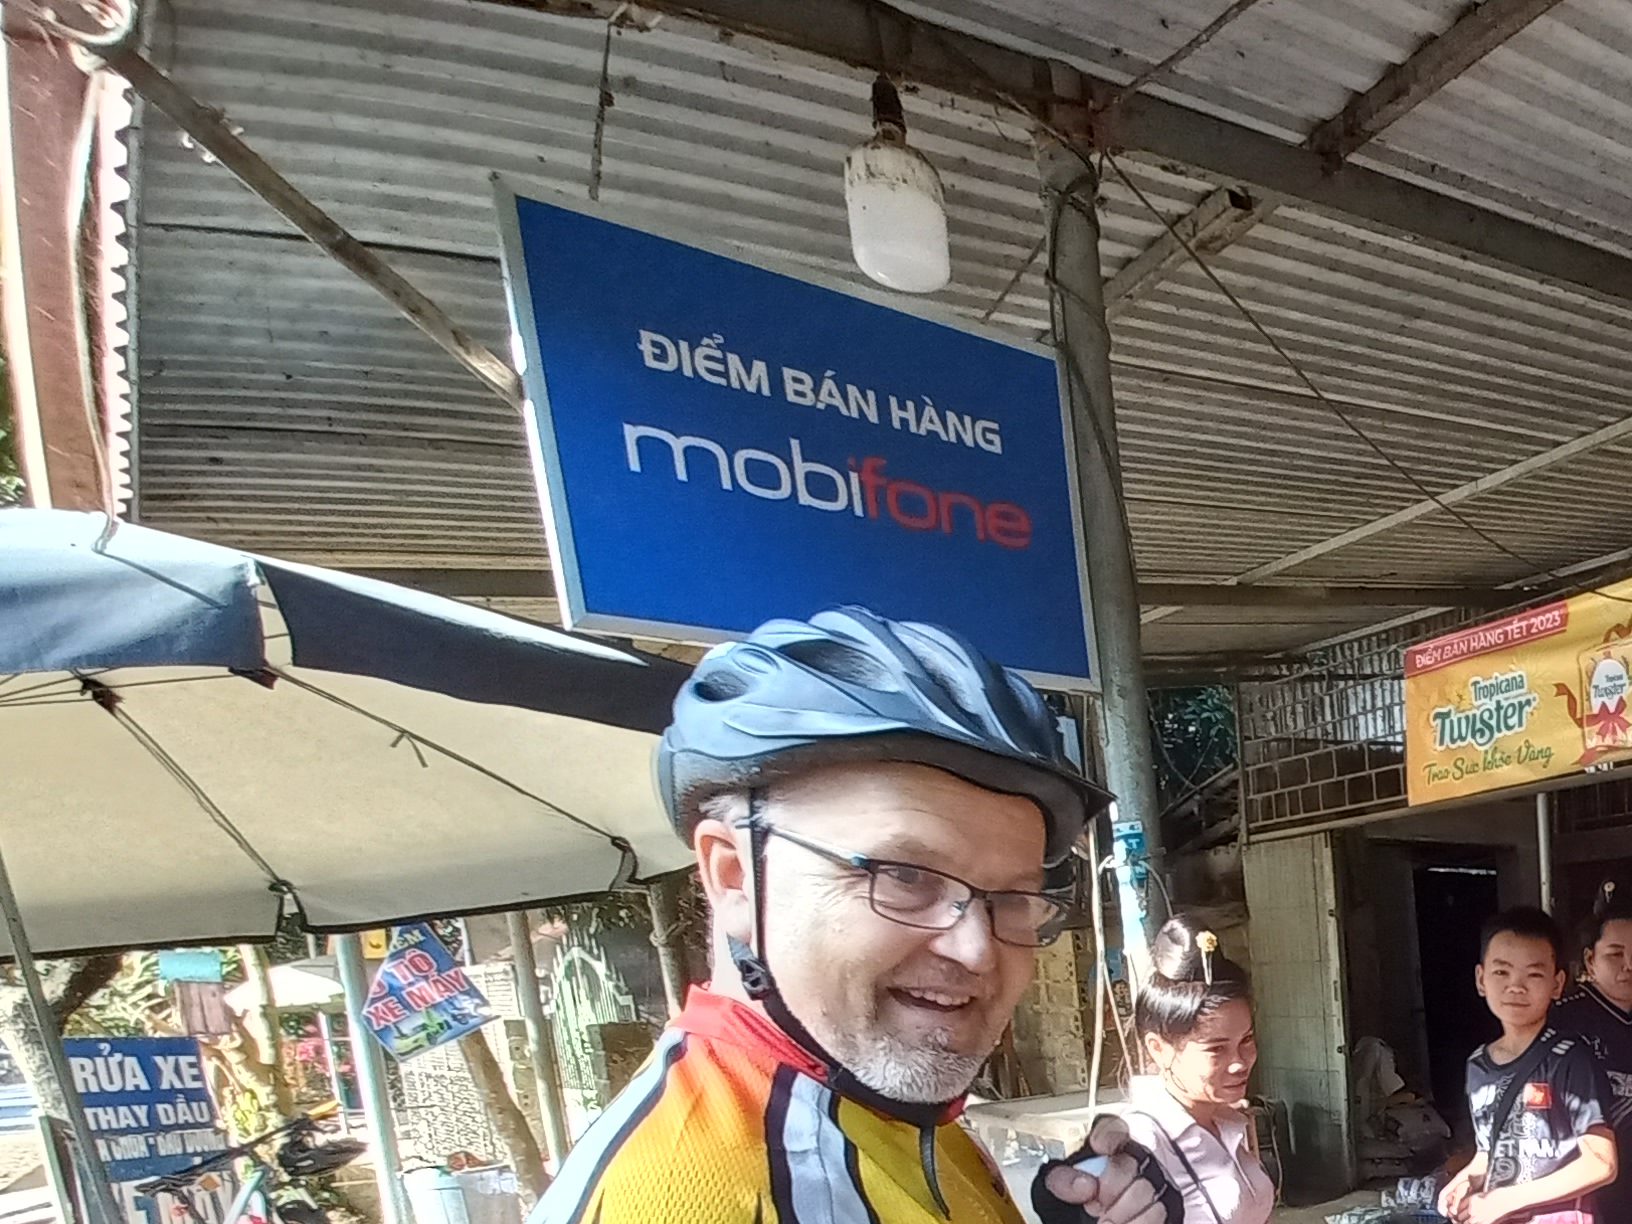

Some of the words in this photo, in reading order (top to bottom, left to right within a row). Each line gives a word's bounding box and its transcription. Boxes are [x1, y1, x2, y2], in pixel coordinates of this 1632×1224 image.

[637, 329, 771, 397] ĐIỂM
[782, 368, 879, 425] BÁN
[890, 396, 1003, 455] HÀNG
[622, 421, 1032, 549] mobifone
[1469, 631, 1505, 651] HÀNG
[1505, 616, 1529, 641] TẾT
[1529, 610, 1562, 634] 2023
[1471, 673, 1525, 702] Tropicana
[1432, 697, 1533, 747] Twister
[1422, 762, 1451, 786] Trao
[363, 996, 411, 1031] XE
[402, 966, 470, 1012] MÁY
[68, 1043, 151, 1093] RỬA
[153, 1055, 206, 1091] XE
[83, 1104, 150, 1131] THAY
[156, 1094, 212, 1126] DẦU
